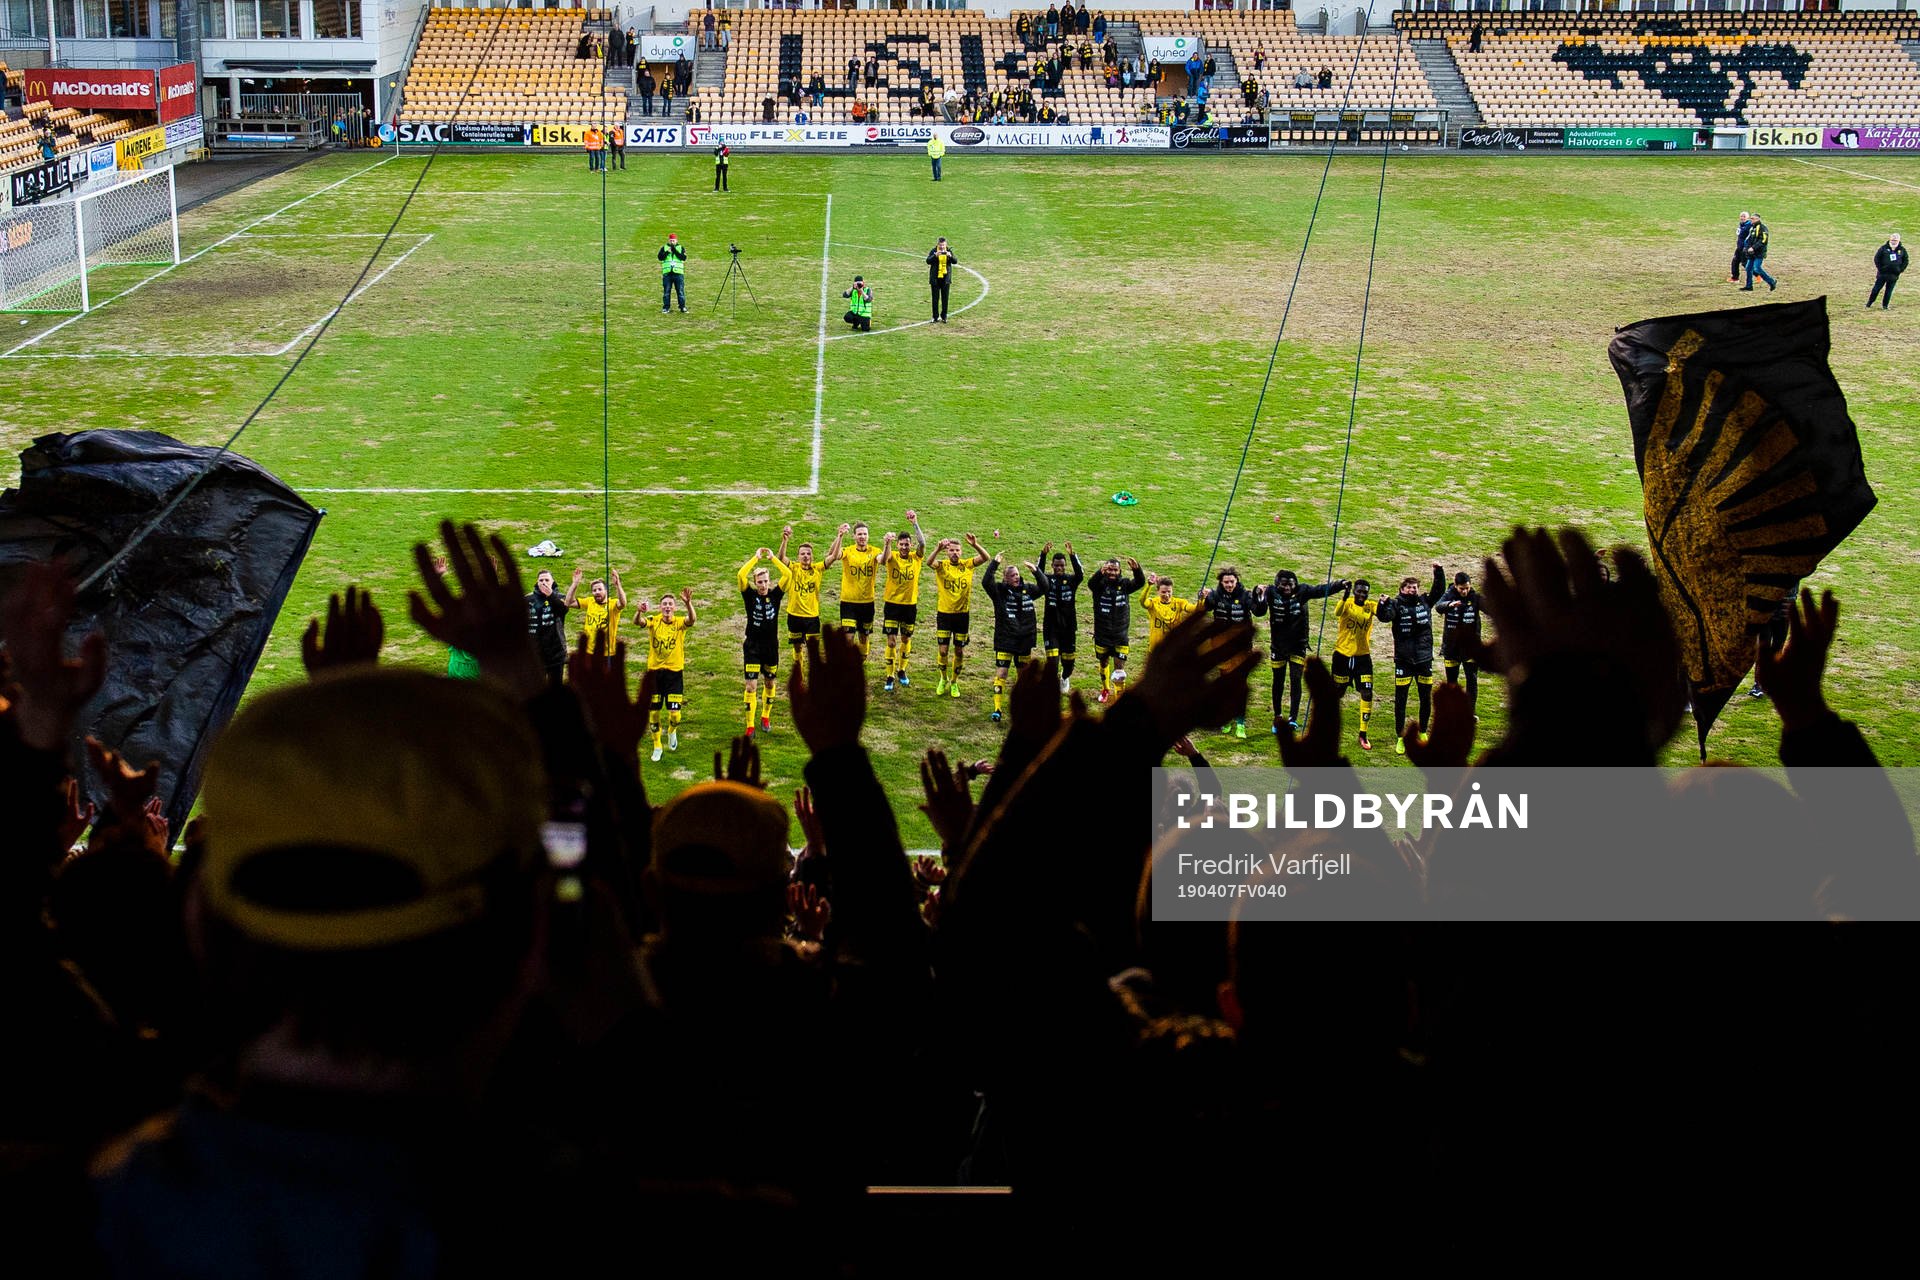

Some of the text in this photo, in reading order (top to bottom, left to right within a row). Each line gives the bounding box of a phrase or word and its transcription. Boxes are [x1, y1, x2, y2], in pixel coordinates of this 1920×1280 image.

[651, 44, 683, 59] dynea
[1152, 46, 1185, 60] dynea
[52, 81, 150, 96] McDonald's
[168, 80, 194, 100] McDonald's
[400, 124, 449, 142] SAC
[631, 128, 678, 143] SATS
[690, 127, 747, 144] STENERUD
[750, 128, 848, 142] FLEXLEIE
[880, 128, 932, 137] BILGLASS
[996, 133, 1050, 145] MAGELI
[1129, 127, 1169, 137] PRINSDAL
[1462, 130, 1493, 146] Casa
[1568, 137, 1623, 146] Halvorsen
[1625, 137, 1633, 146] &
[849, 563, 874, 580] DNB
[891, 565, 915, 584] DNB
[943, 577, 968, 592] DNB
[652, 636, 677, 655] DNB
